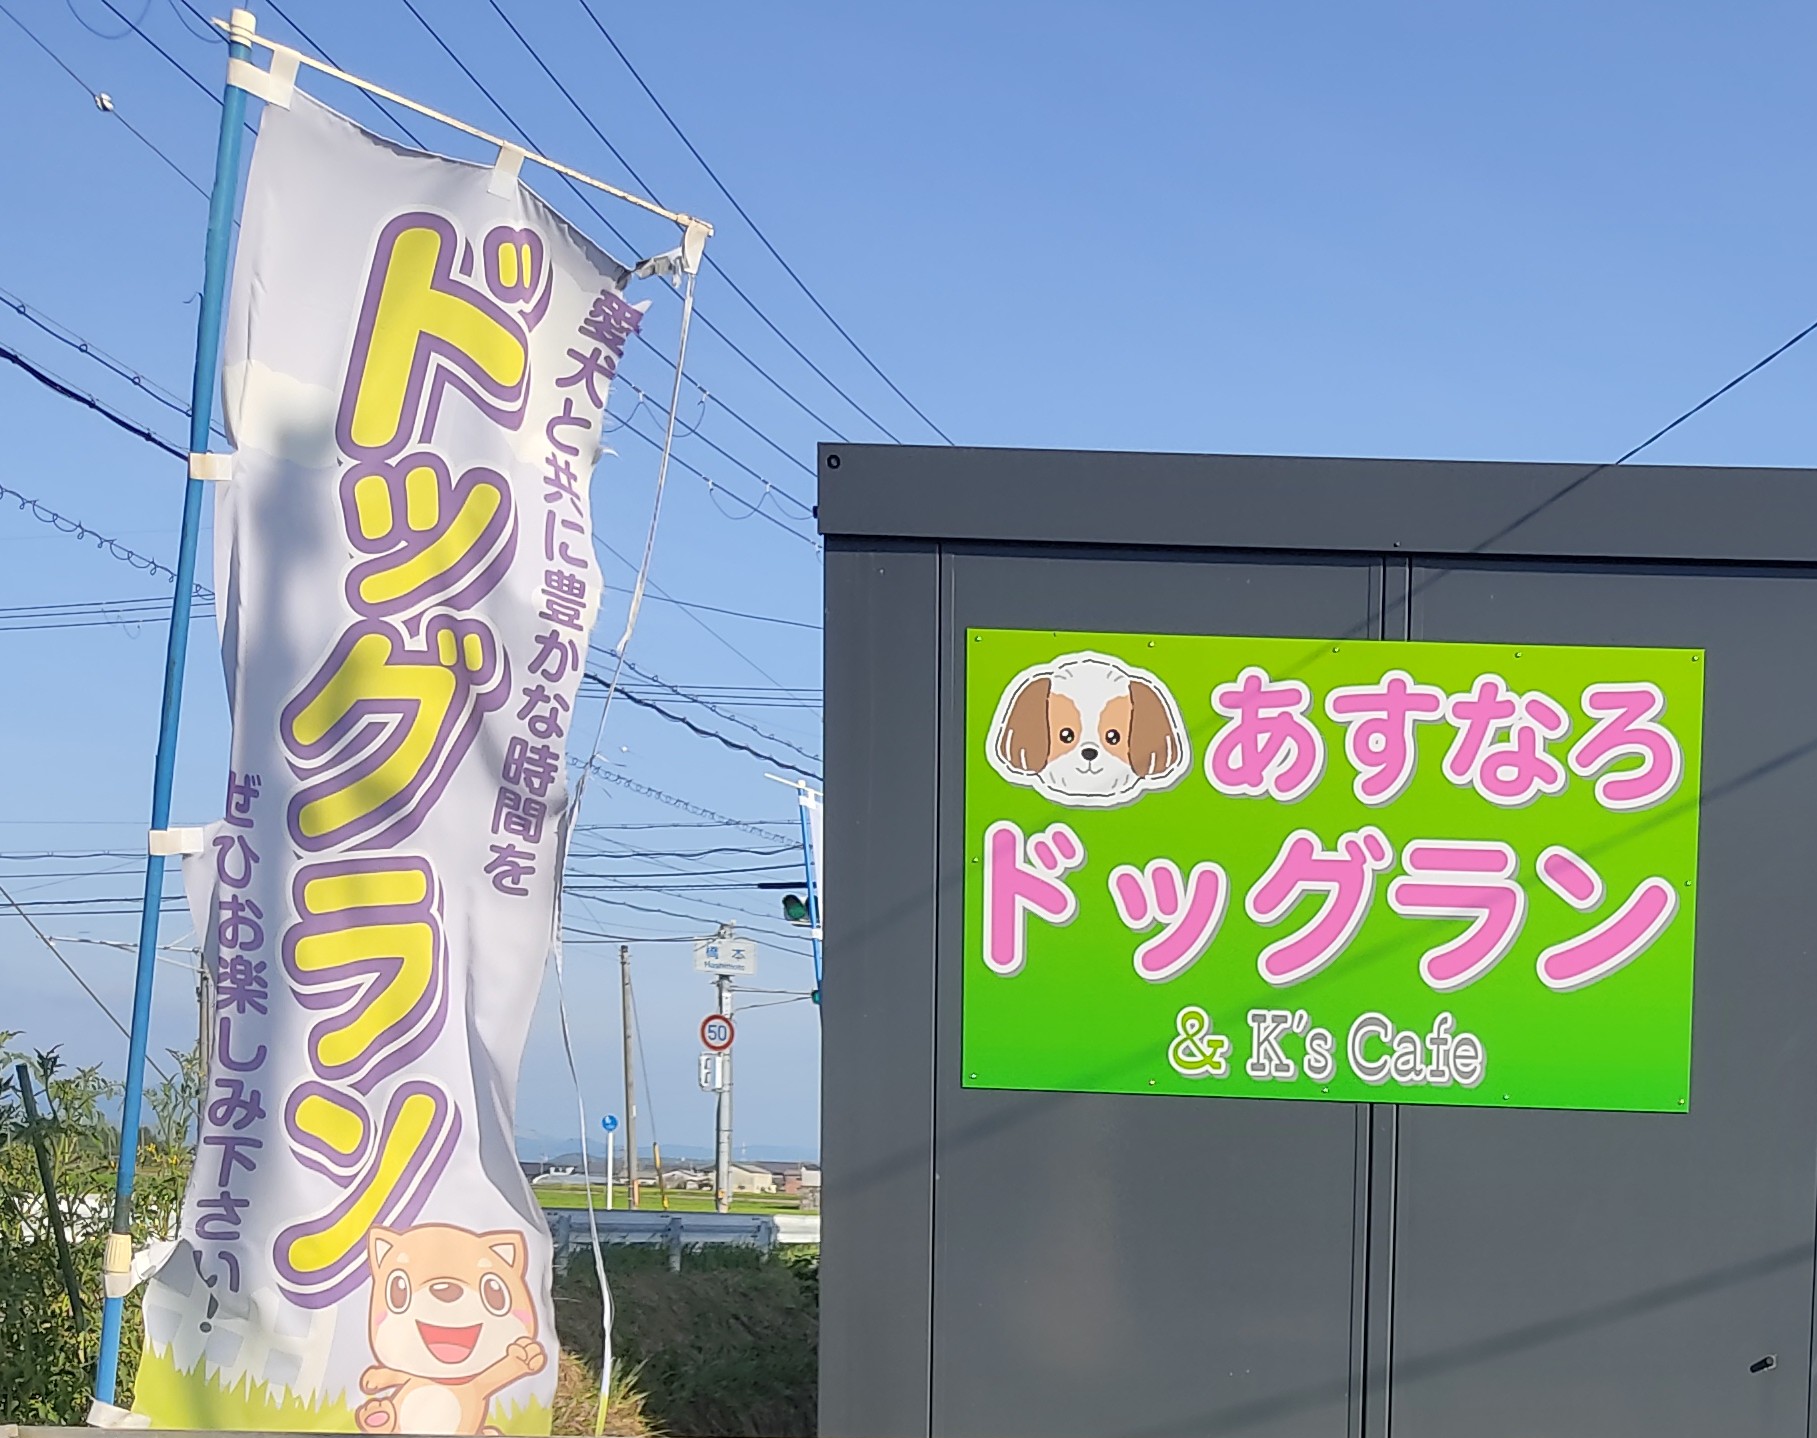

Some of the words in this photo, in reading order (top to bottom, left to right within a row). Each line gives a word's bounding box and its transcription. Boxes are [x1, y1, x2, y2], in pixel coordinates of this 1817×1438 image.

[484, 288, 642, 896] 愛犬と共に豊かな時間を
[274, 212, 553, 1310] ドッグラン
[1206, 668, 1682, 809] あすなろ
[983, 820, 1680, 990] ドッグラン
[708, 1025, 727, 1041] 50
[1169, 1007, 1229, 1079] &
[1247, 1008, 1332, 1079] K's
[1347, 1012, 1487, 1084] Cafe
